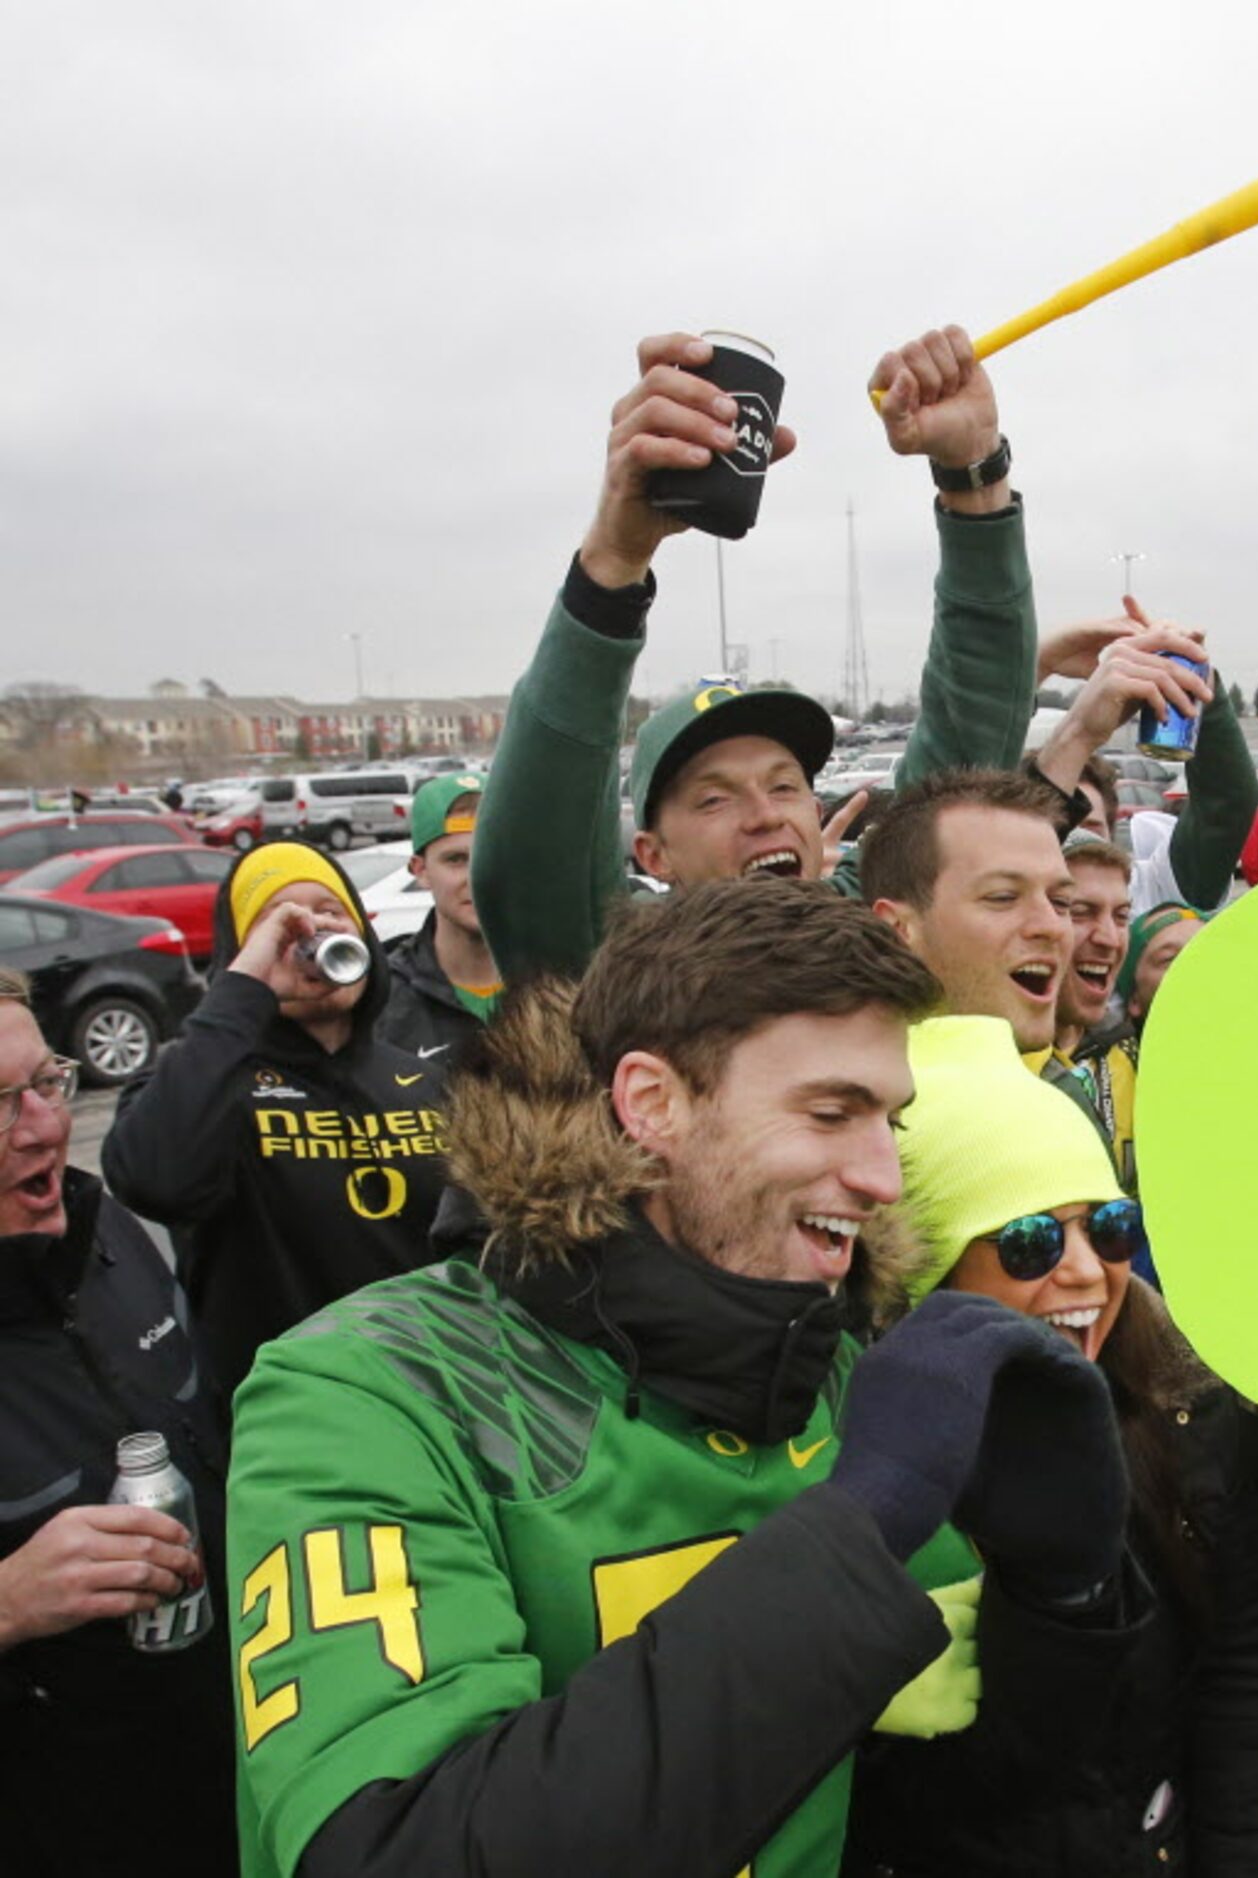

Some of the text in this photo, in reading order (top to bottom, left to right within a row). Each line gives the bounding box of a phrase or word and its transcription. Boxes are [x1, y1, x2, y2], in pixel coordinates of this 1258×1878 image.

[346, 1166, 407, 1220] O
[707, 1430, 748, 1457] O
[239, 1521, 426, 1755] 24
